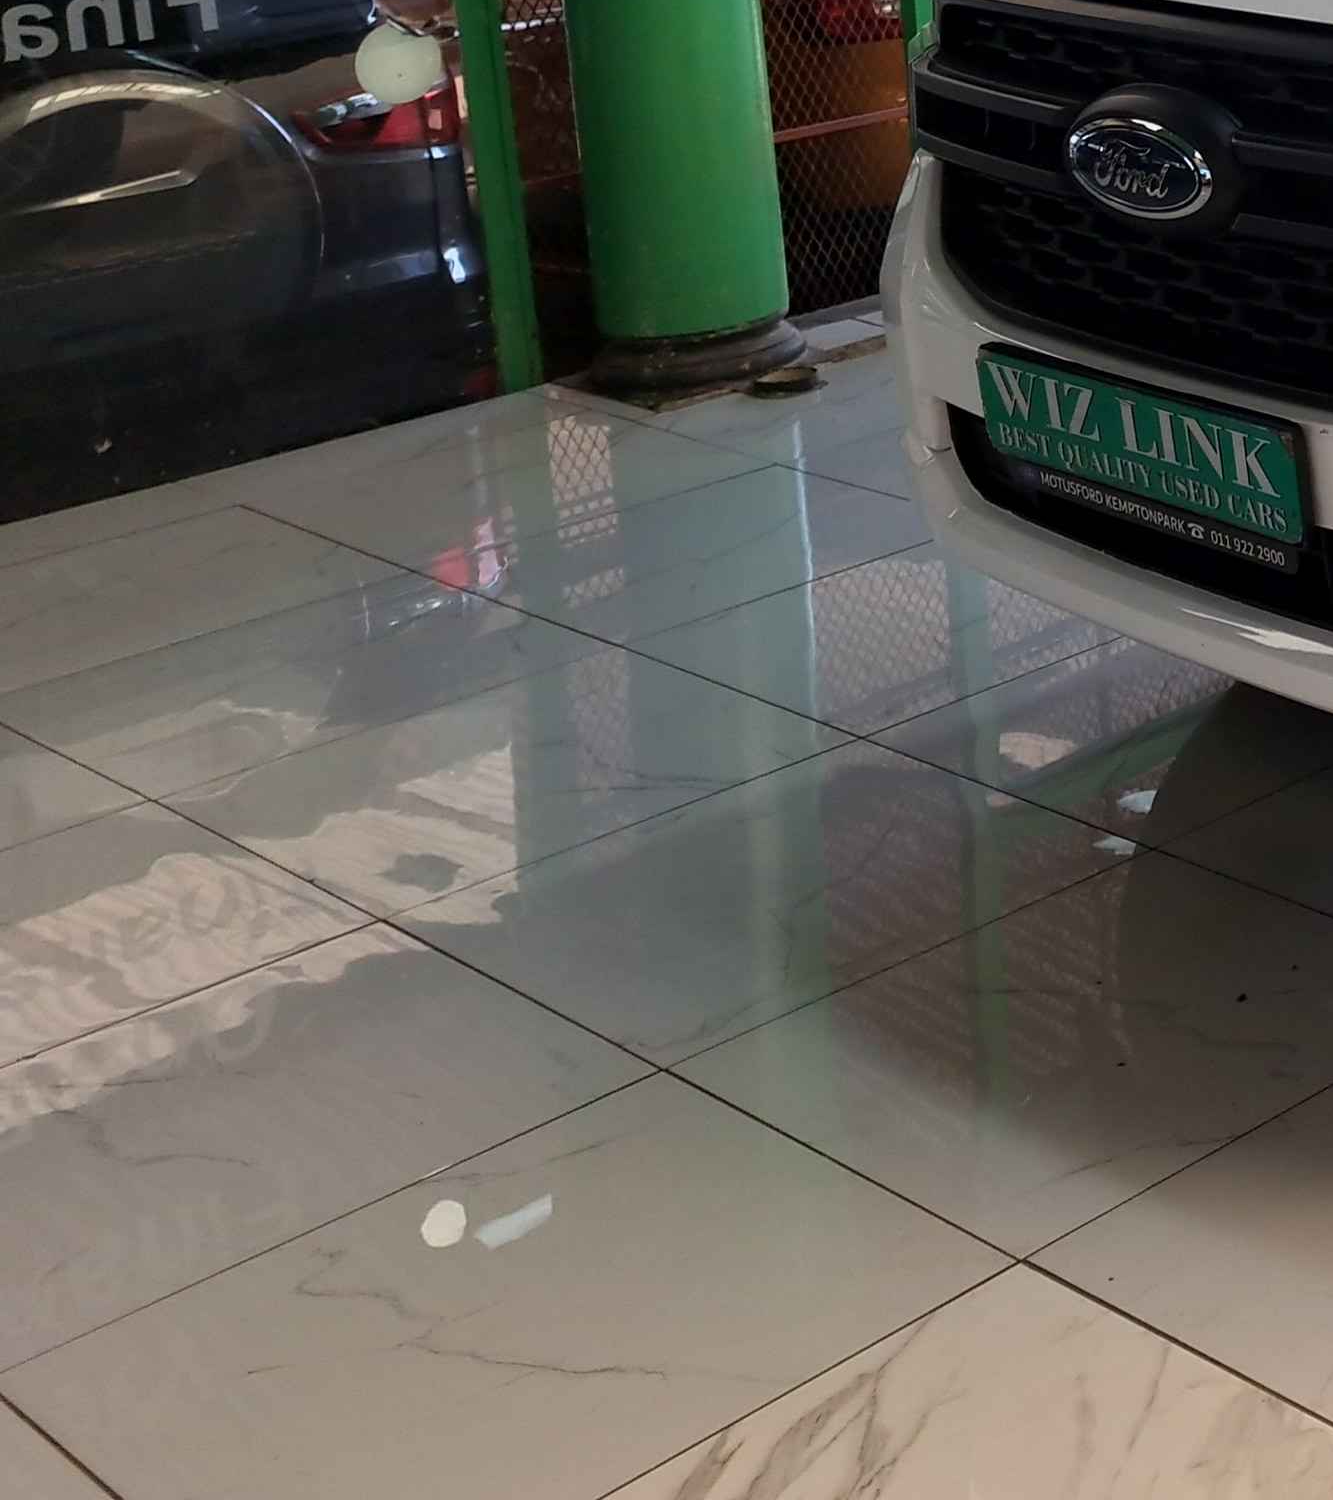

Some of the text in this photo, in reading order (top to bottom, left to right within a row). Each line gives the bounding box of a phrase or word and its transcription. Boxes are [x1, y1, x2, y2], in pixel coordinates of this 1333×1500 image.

[984, 361, 1282, 498] WIZ LINK
[999, 422, 1289, 534] BEST QUALITY USED CARS
[1105, 493, 1187, 534] KEMPTONPARK
[1210, 529, 1232, 551] 011
[1233, 535, 1257, 556] 922
[1257, 541, 1286, 567] 2900
